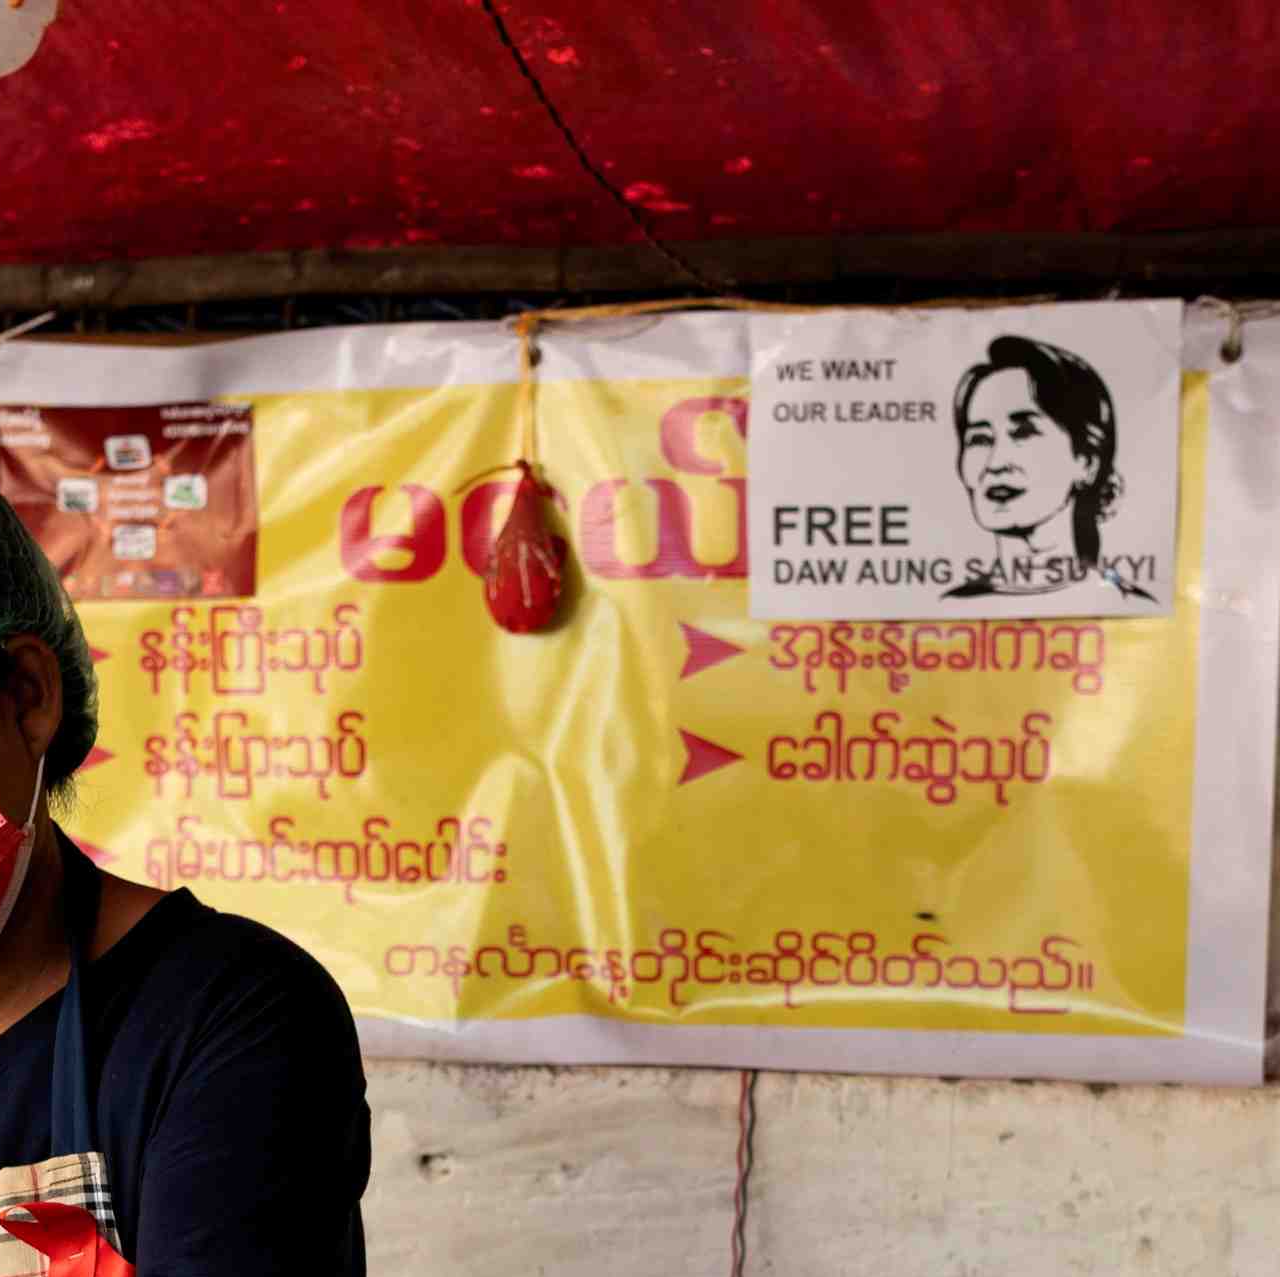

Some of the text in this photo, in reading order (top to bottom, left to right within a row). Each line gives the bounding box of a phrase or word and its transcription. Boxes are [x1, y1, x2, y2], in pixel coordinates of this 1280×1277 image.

[776, 358, 898, 382] WE WANT
[773, 400, 937, 424] OUR LEADER
[773, 505, 910, 546] FREE
[774, 558, 848, 585] DAW
[858, 558, 953, 585] AUNG
[965, 556, 1032, 585] SAN
[767, 711, 1053, 806] ခေါက်ဆွဲသုပ်
